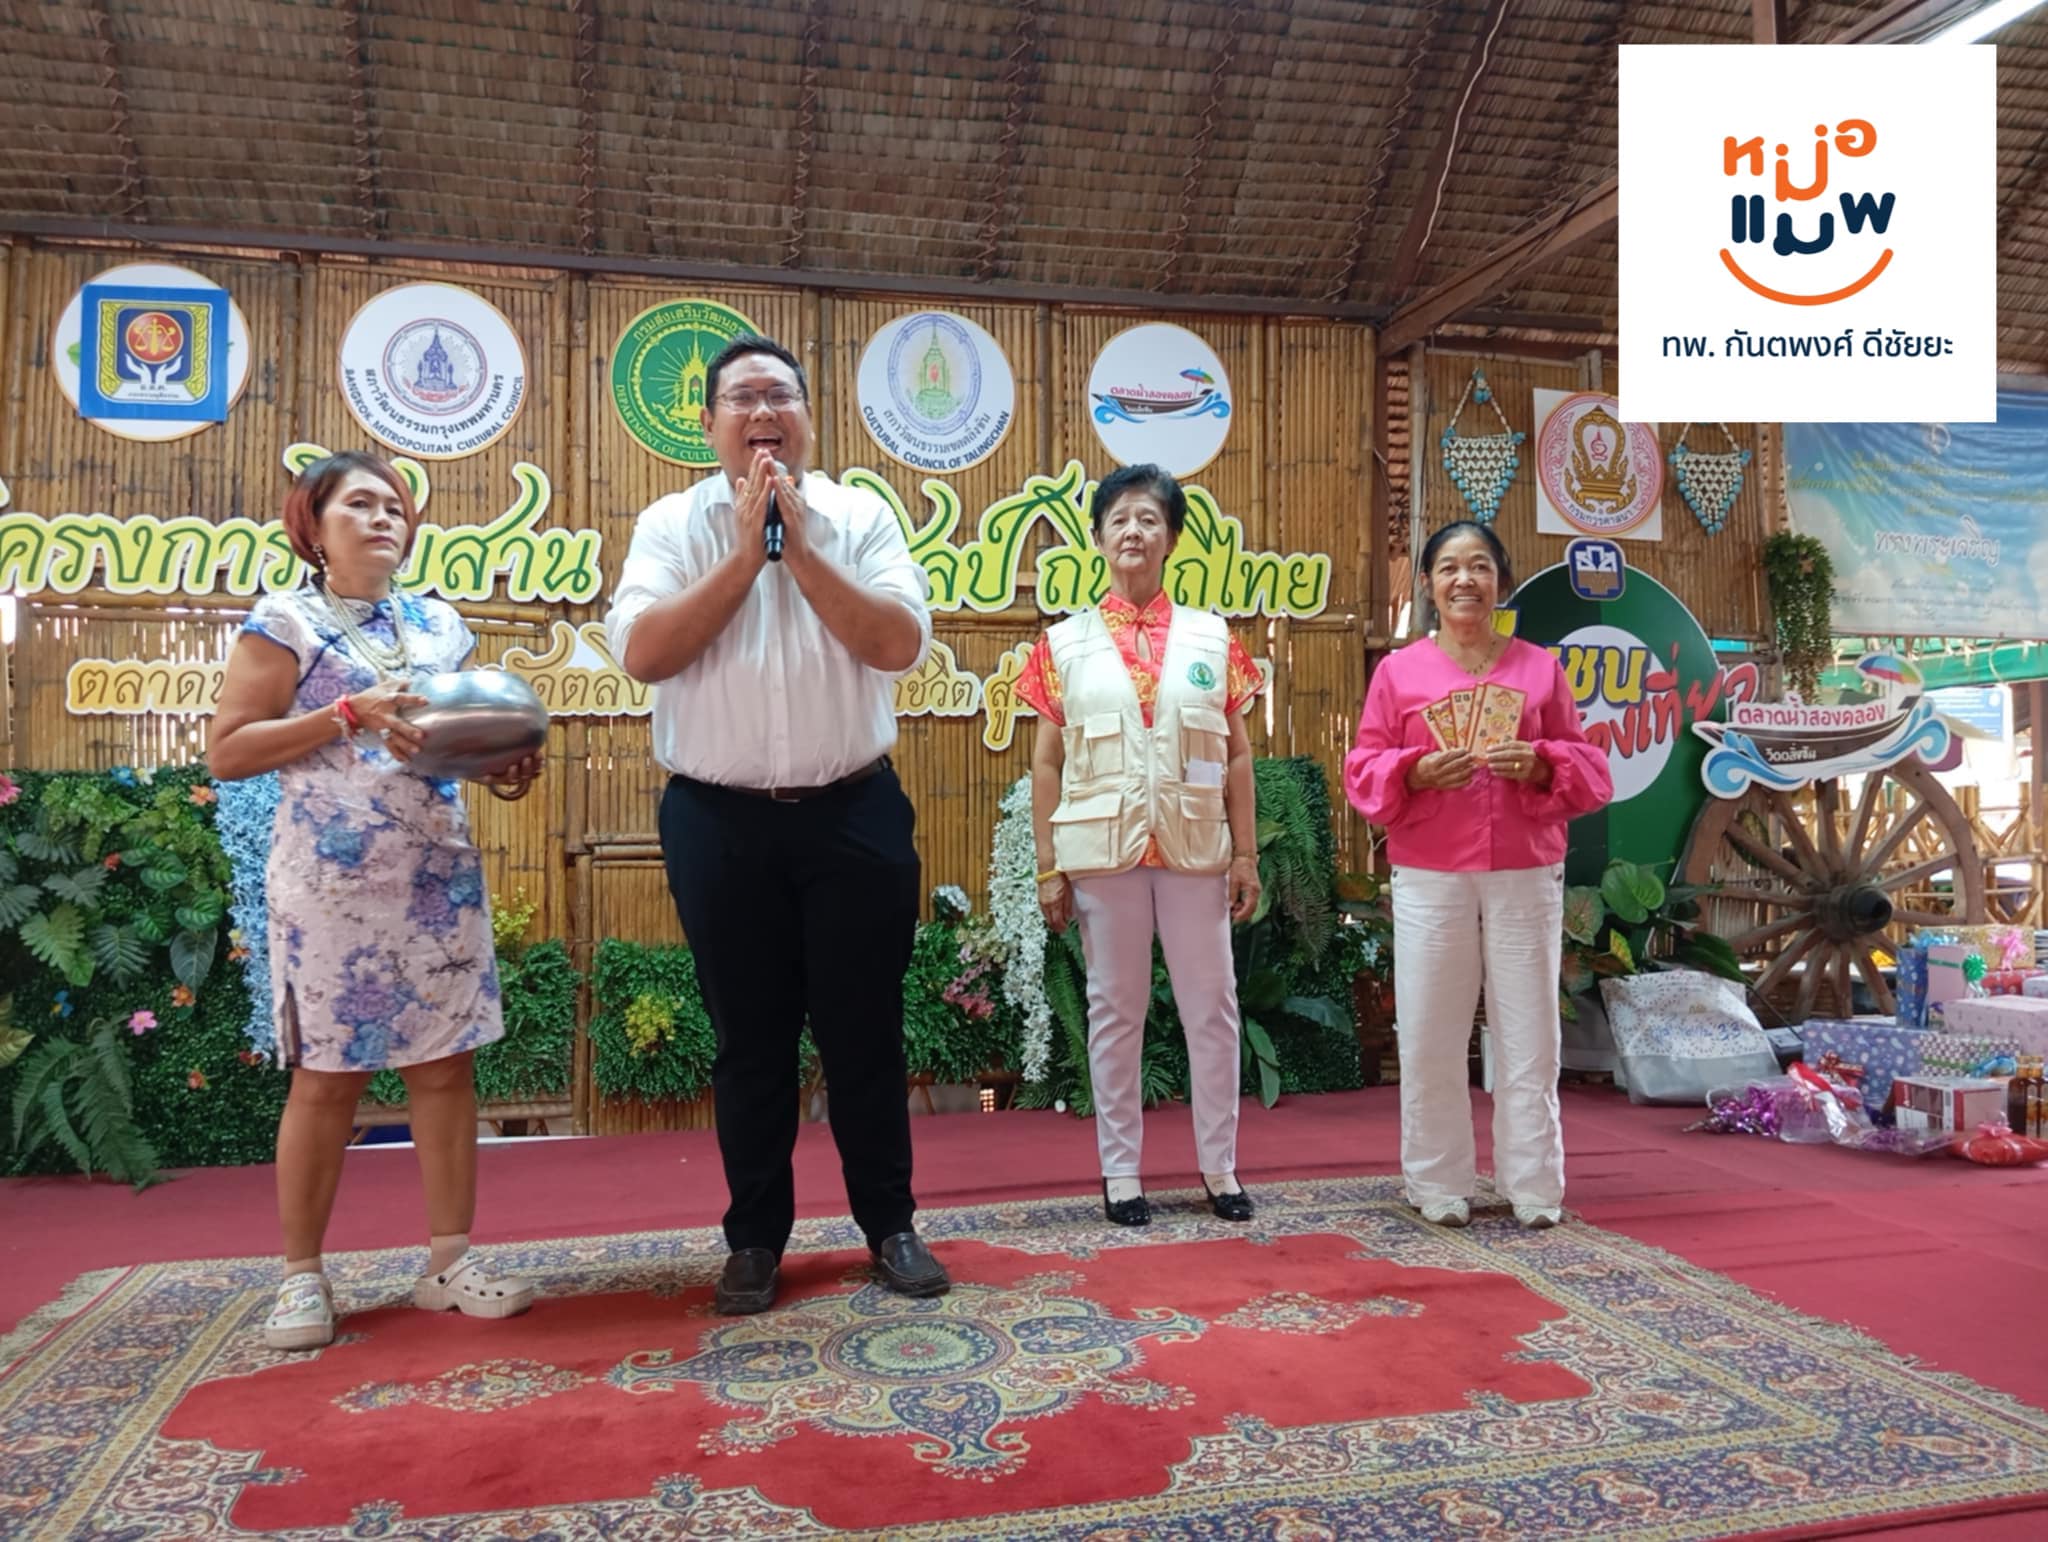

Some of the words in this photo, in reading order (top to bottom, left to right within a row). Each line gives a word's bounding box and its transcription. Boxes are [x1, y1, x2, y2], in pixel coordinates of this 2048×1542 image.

[632, 304, 739, 341] กรมส่งเสริมวัฒนธ
[344, 368, 371, 423] BANGKOK
[372, 420, 453, 453] METROPOLITAN
[456, 421, 505, 451] CULTURAL
[501, 375, 524, 424] COUNCIL
[365, 368, 504, 440] สภาวัฒนธรรมกรุงเทพมหานคร
[615, 384, 662, 448] DEPARTMENT
[662, 443, 678, 456] OF
[679, 448, 717, 462] CULTU
[862, 405, 900, 455] CULTURAL
[903, 450, 948, 470] COUNCIL
[949, 456, 962, 467] OF
[963, 410, 1010, 463] TALINGCHAN
[1737, 696, 1886, 727] ตลาดน้ำสองคลอง
